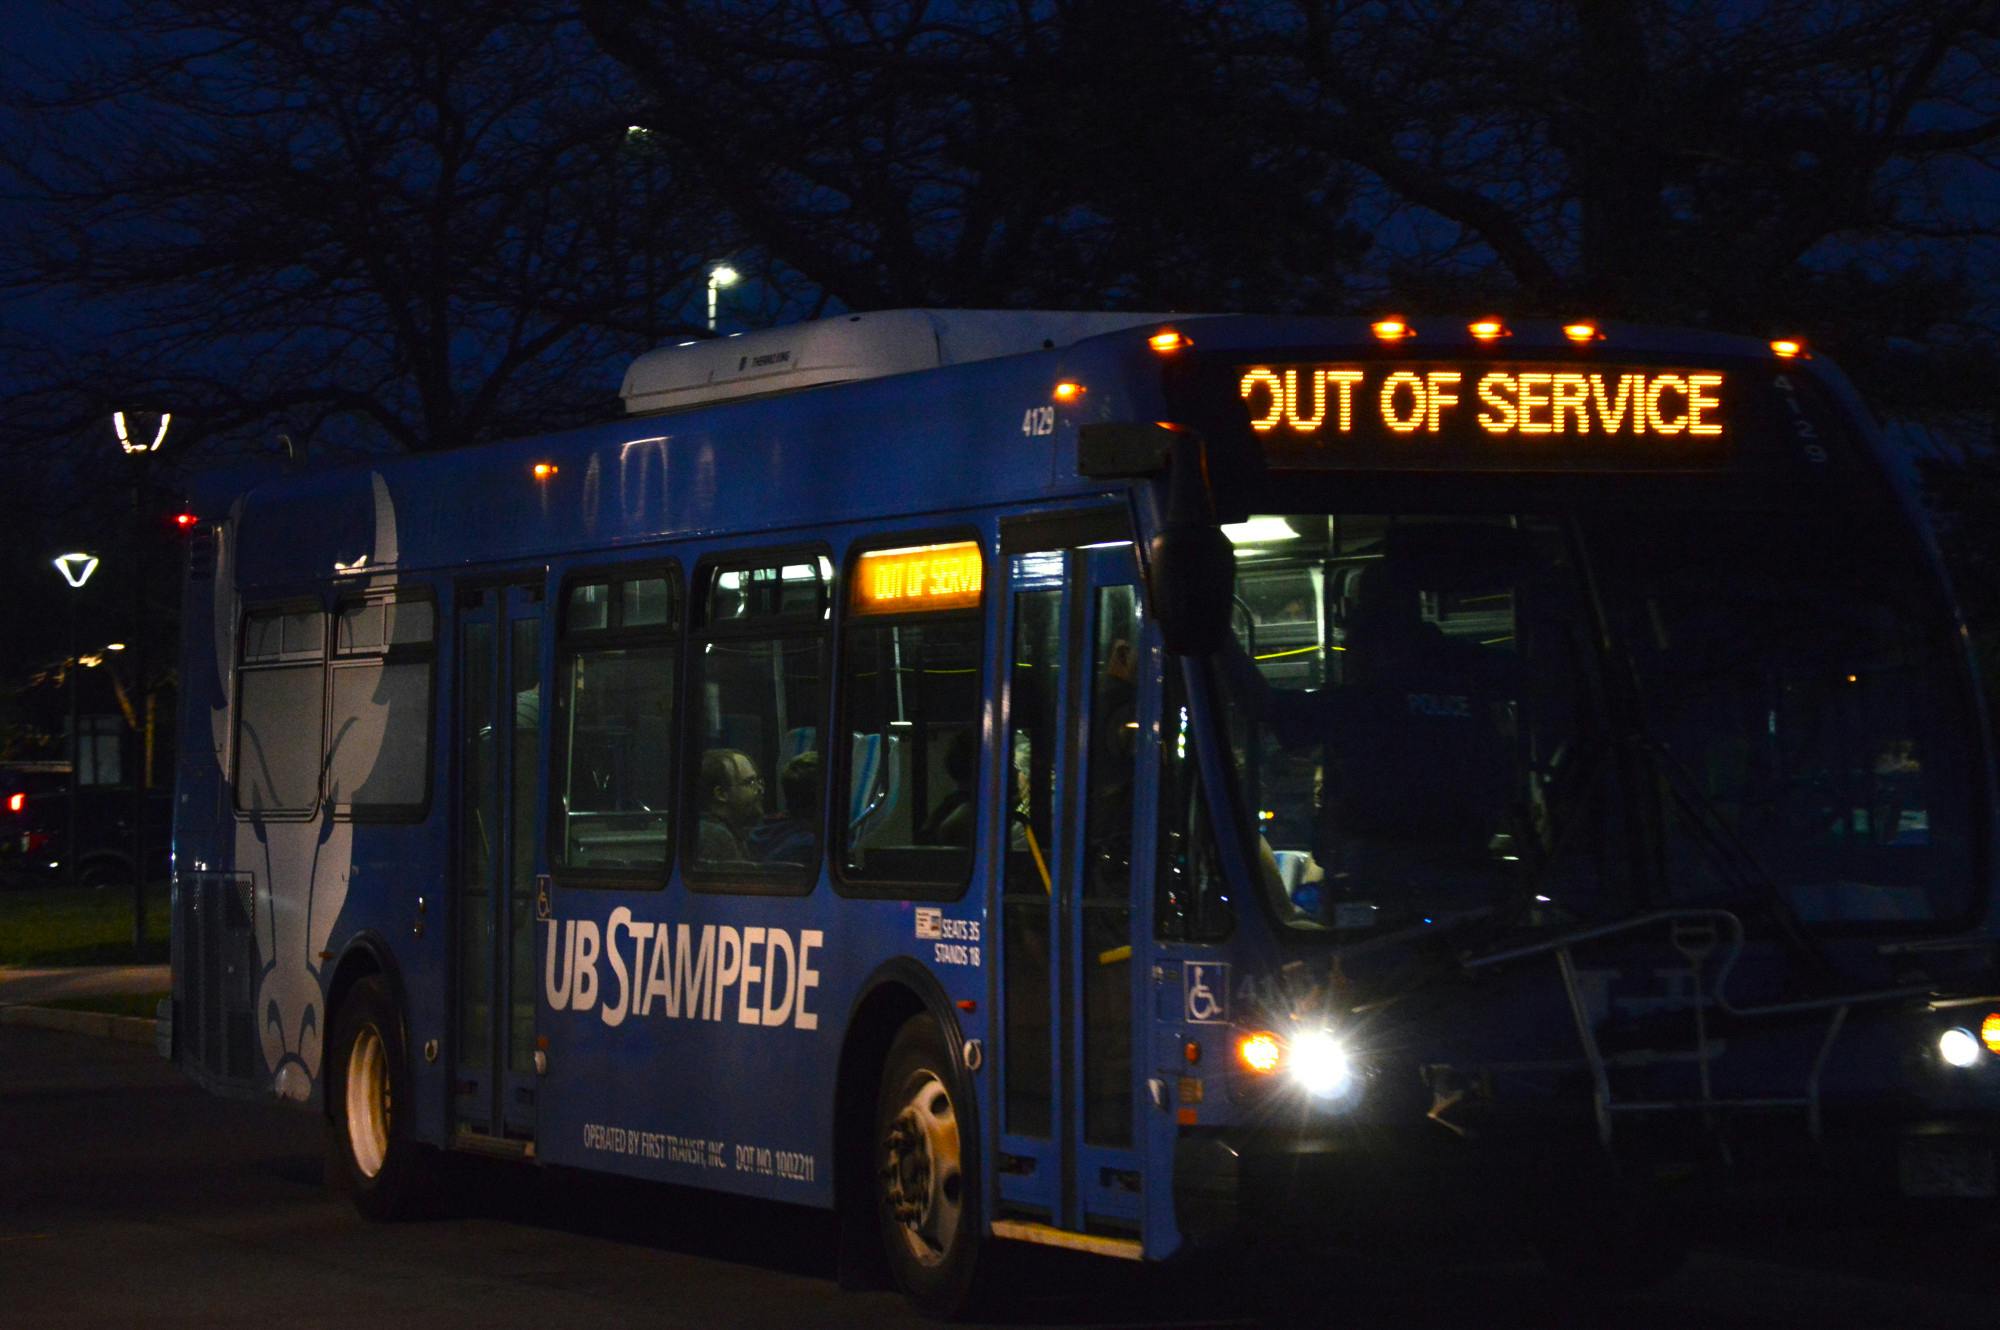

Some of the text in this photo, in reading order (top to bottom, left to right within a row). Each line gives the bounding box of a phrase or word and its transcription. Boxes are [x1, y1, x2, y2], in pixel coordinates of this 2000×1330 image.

[1022, 405, 1055, 437] 4129
[1240, 368, 1723, 435] OUT OF SERVICE
[1774, 374, 1828, 463] 4129
[934, 942, 968, 966] STANDS
[942, 918, 968, 940] SEATS
[968, 920, 981, 942] 35
[601, 905, 824, 1031] STAMPEDE
[583, 1122, 626, 1154] OPERATED
[627, 1129, 641, 1156] BY
[641, 1131, 665, 1161] FIRST
[735, 1144, 755, 1173] DOT
